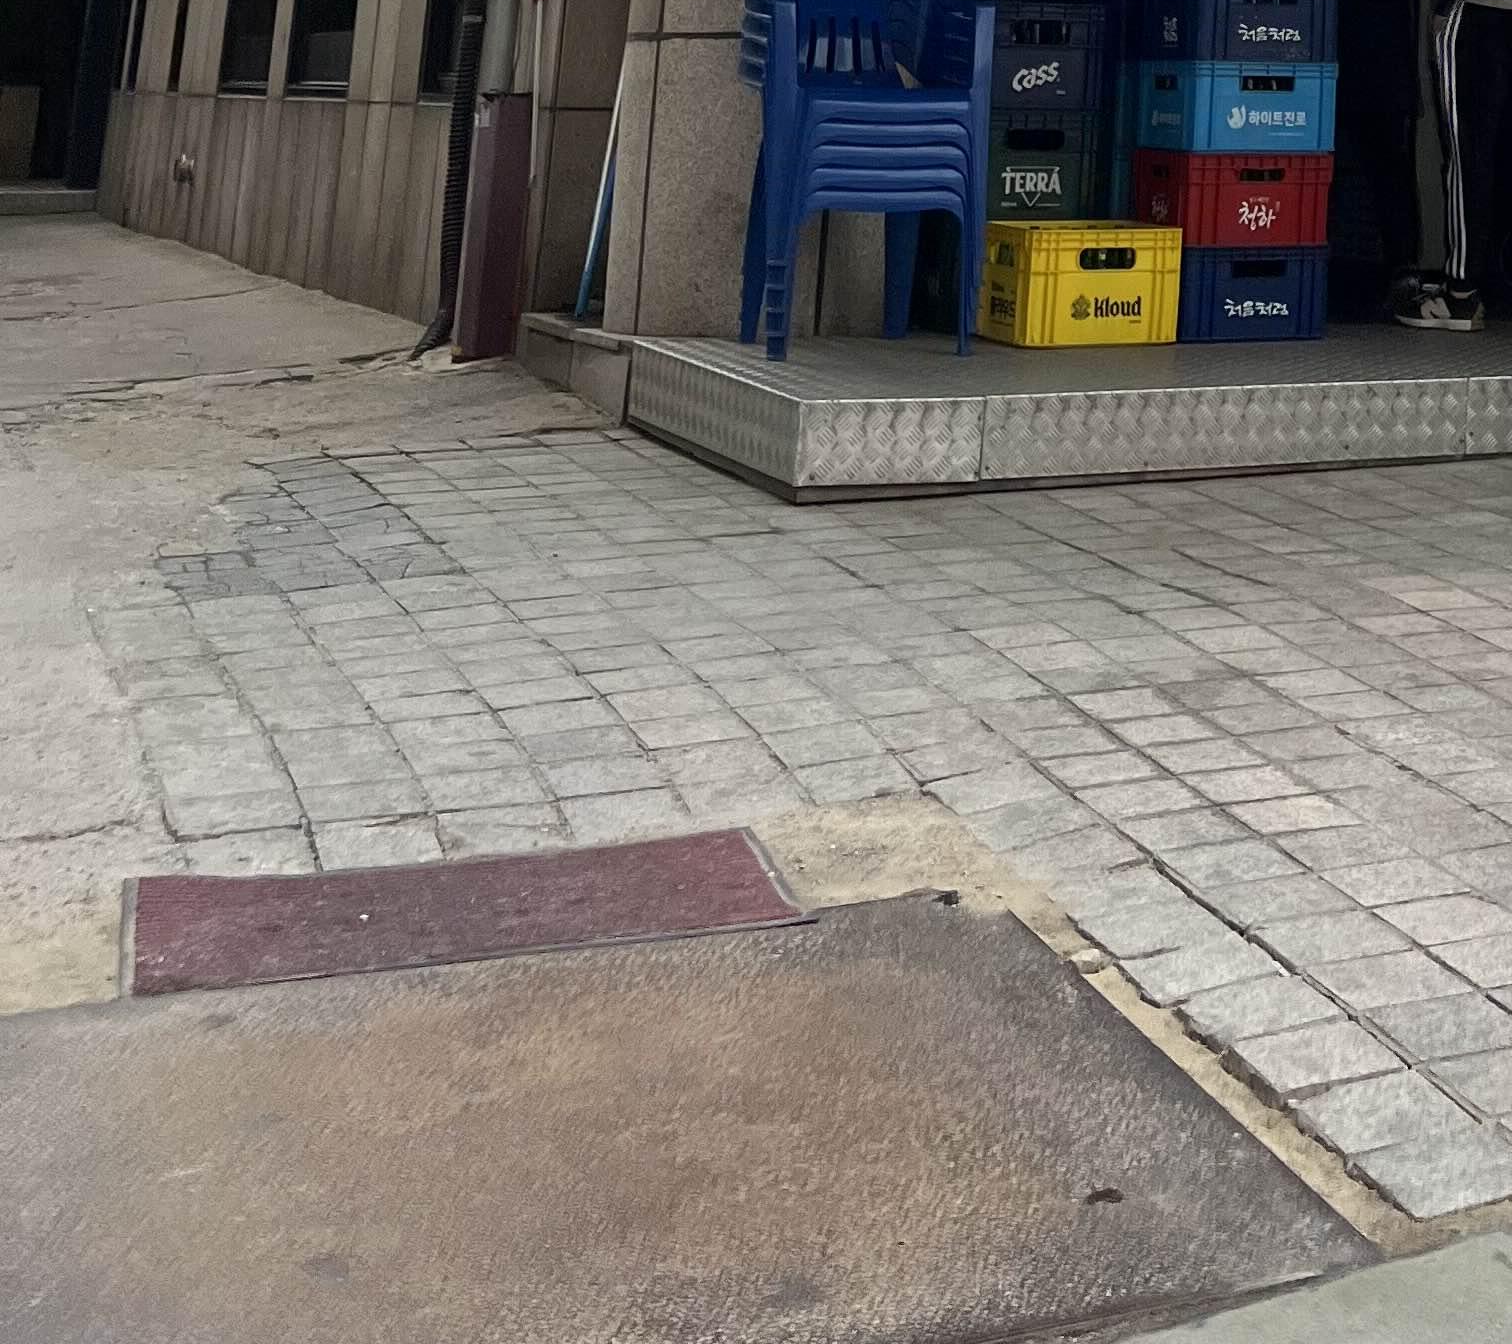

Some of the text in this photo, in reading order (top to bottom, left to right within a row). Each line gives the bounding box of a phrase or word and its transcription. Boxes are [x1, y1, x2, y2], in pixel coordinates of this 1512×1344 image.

[1238, 22, 1303, 43] 처음처럼
[1248, 109, 1307, 128] 하이트진로
[1001, 169, 1062, 196] TERRA
[1237, 202, 1279, 231] 청하
[1094, 295, 1142, 319] Kloud
[1224, 298, 1290, 319] 처음처럼
